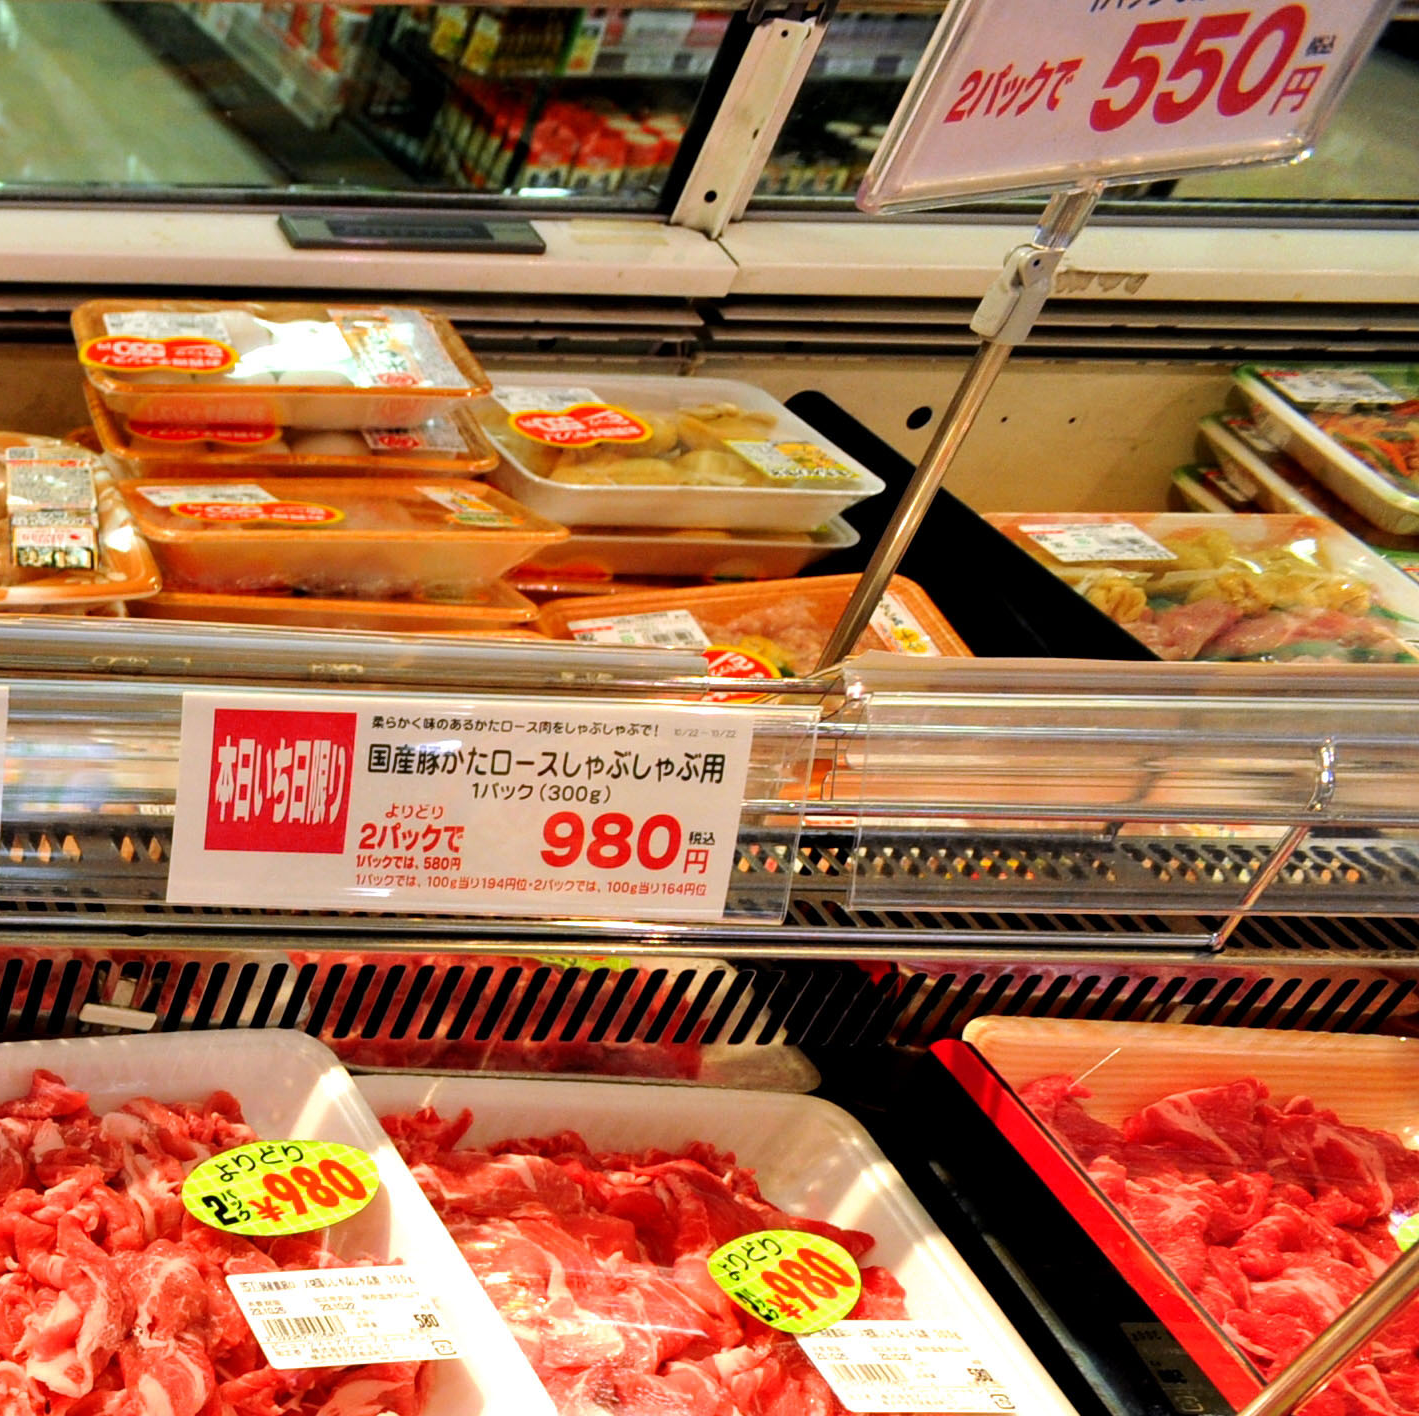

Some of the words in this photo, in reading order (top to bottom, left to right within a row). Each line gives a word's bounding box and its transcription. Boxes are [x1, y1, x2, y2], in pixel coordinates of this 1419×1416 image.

[944, 58, 1082, 124] 2パックで
[216, 734, 345, 830] 本日いち日限り
[368, 744, 726, 783] 国産豚かたロースしゃぶしゃぶ用
[385, 803, 444, 819] よりどり
[358, 824, 464, 852] 2パックで
[215, 1145, 304, 1183] よりどり
[414, 1314, 439, 1328] 580
